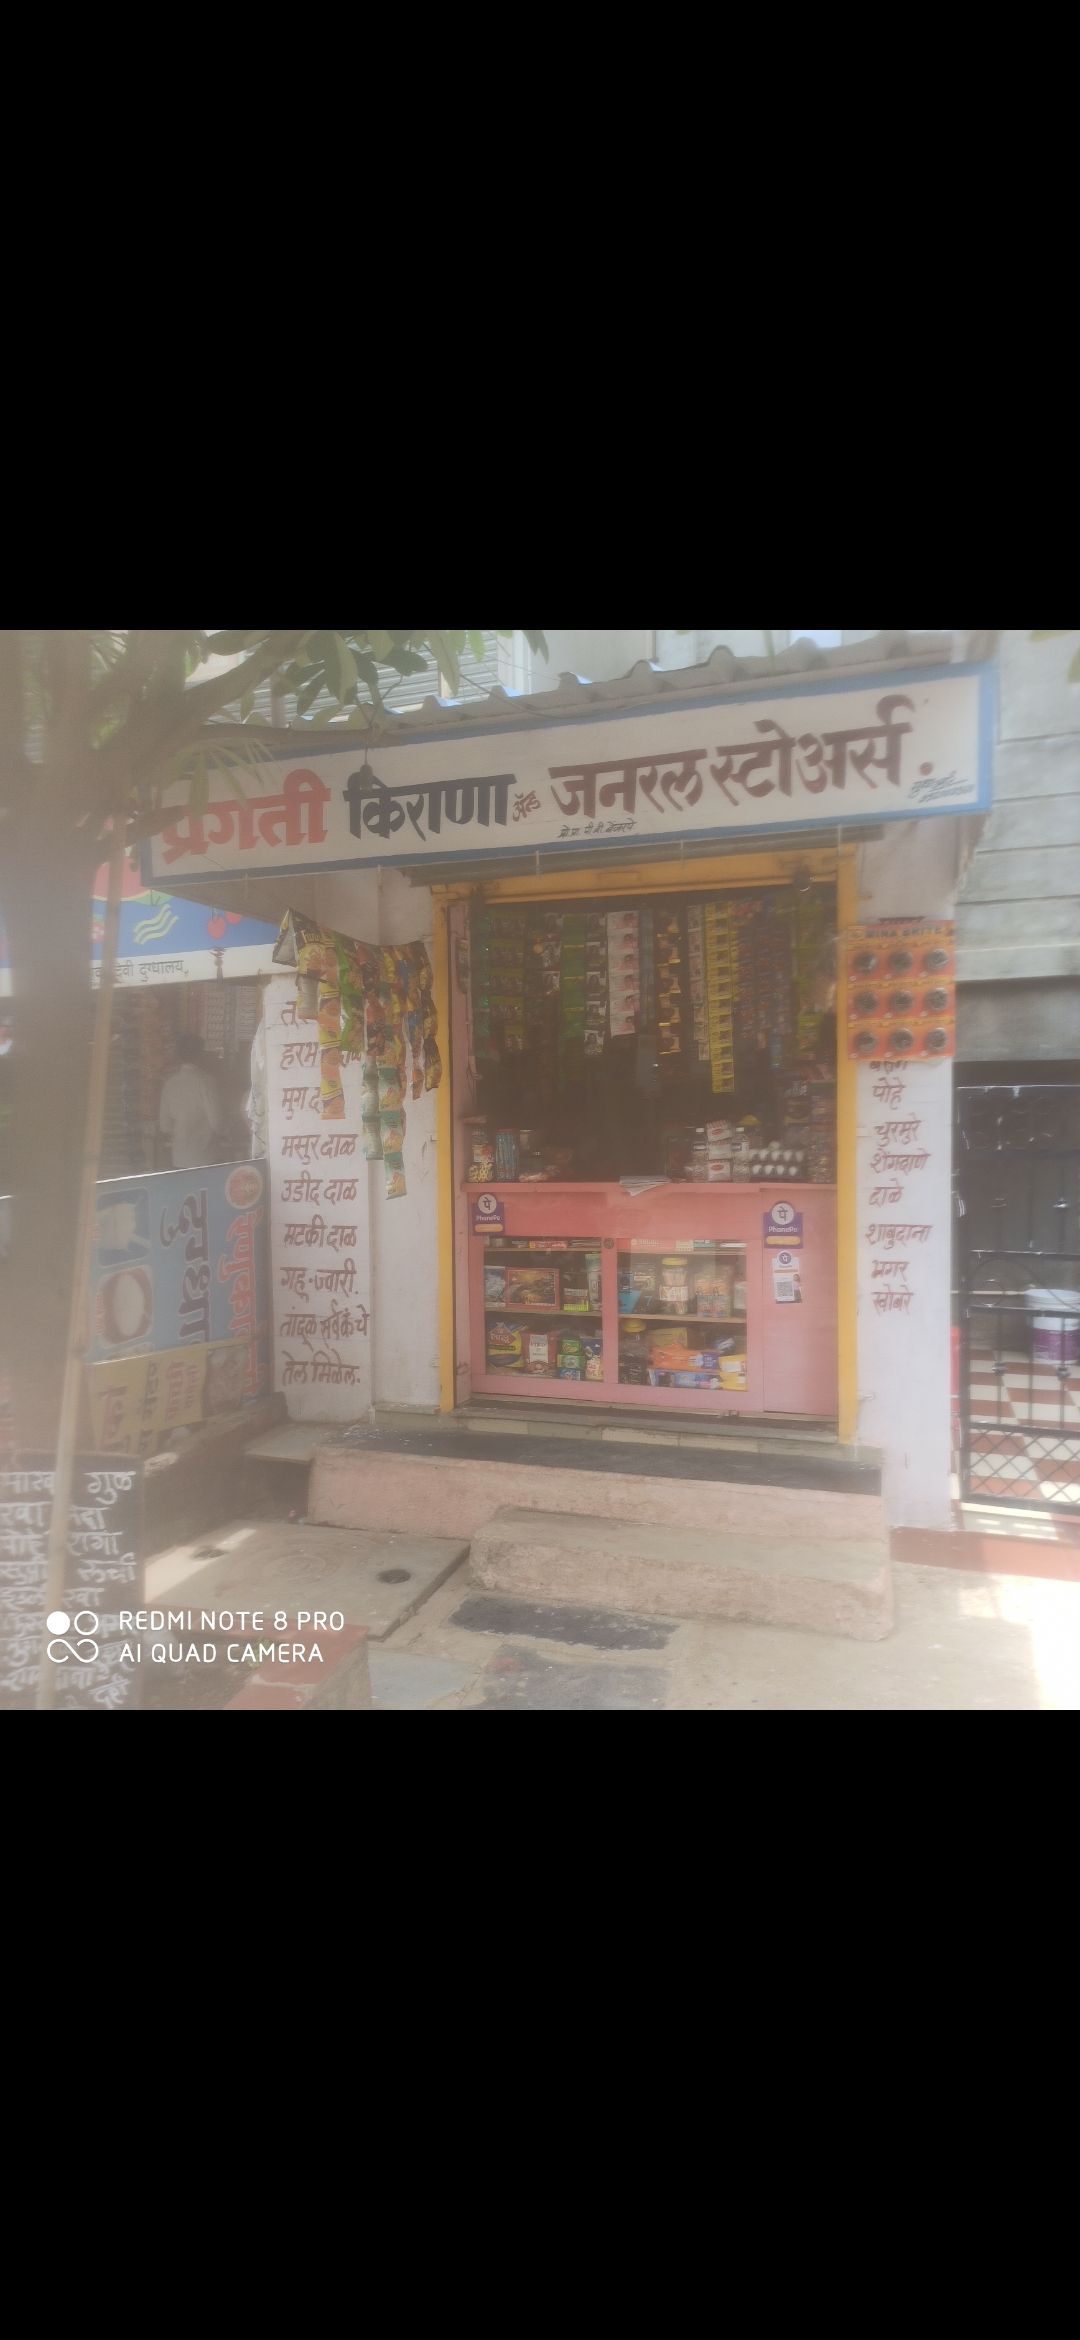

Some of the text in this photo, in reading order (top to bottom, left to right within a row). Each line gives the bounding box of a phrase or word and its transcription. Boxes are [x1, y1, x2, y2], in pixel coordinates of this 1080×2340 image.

[162, 769, 331, 865] प्रगती
[343, 764, 517, 841] किराणा
[548, 749, 707, 820] जनरल
[284, 1214, 327, 1248] मटकी
[281, 1350, 309, 1386] तेल
